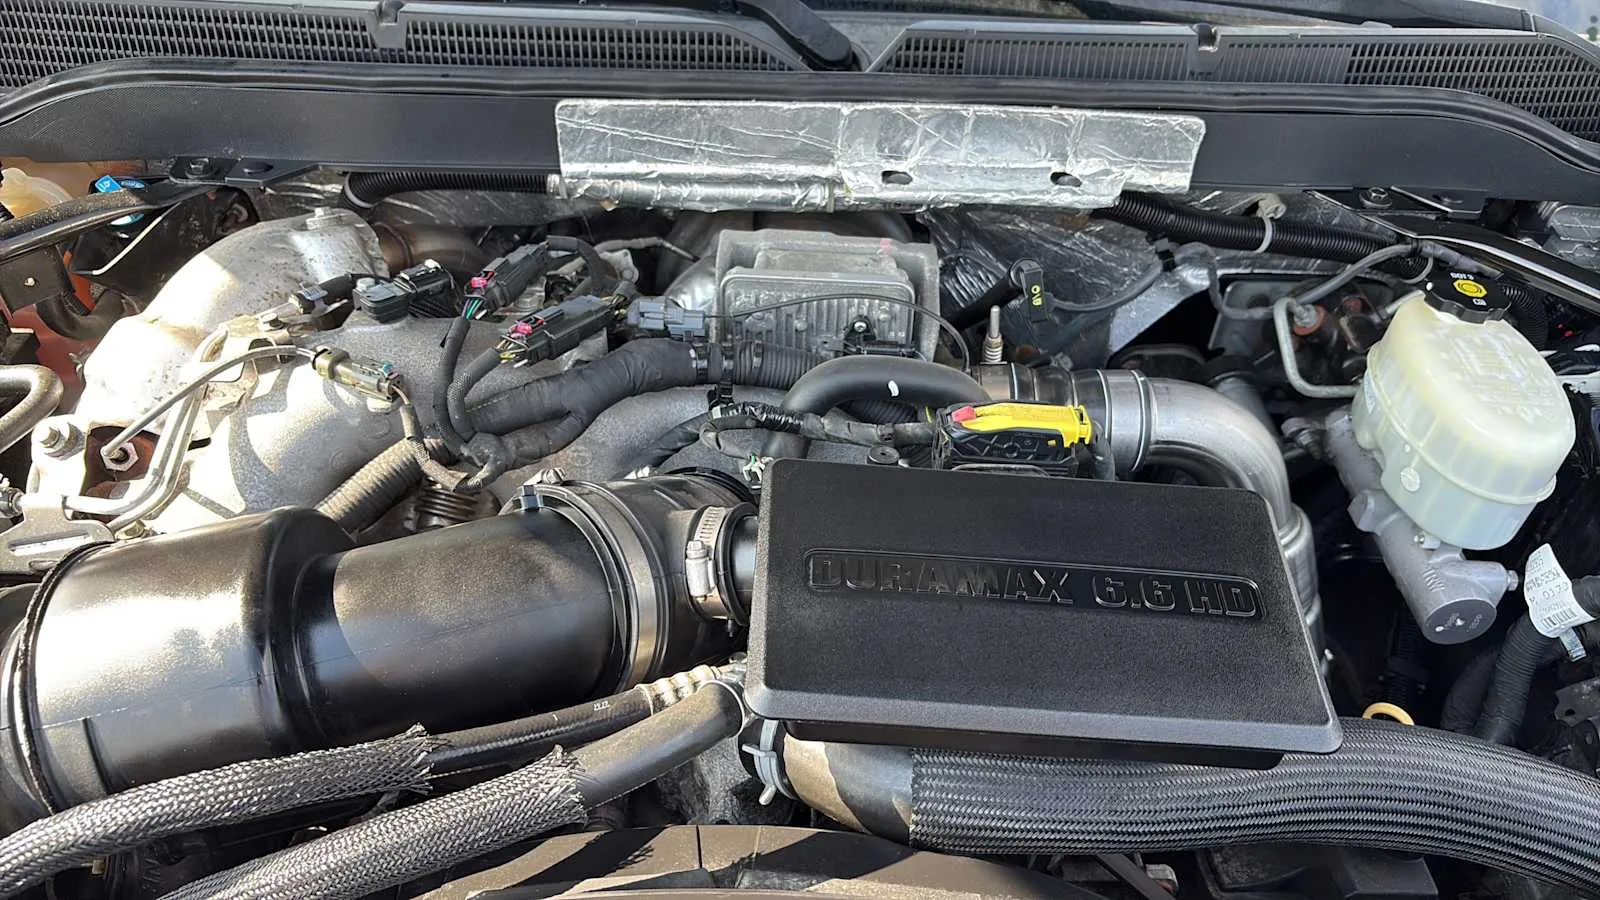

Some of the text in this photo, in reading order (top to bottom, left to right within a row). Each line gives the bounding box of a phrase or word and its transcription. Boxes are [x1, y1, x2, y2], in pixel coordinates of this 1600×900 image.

[808, 554, 1258, 617] DURAMAX 6.6 HD
